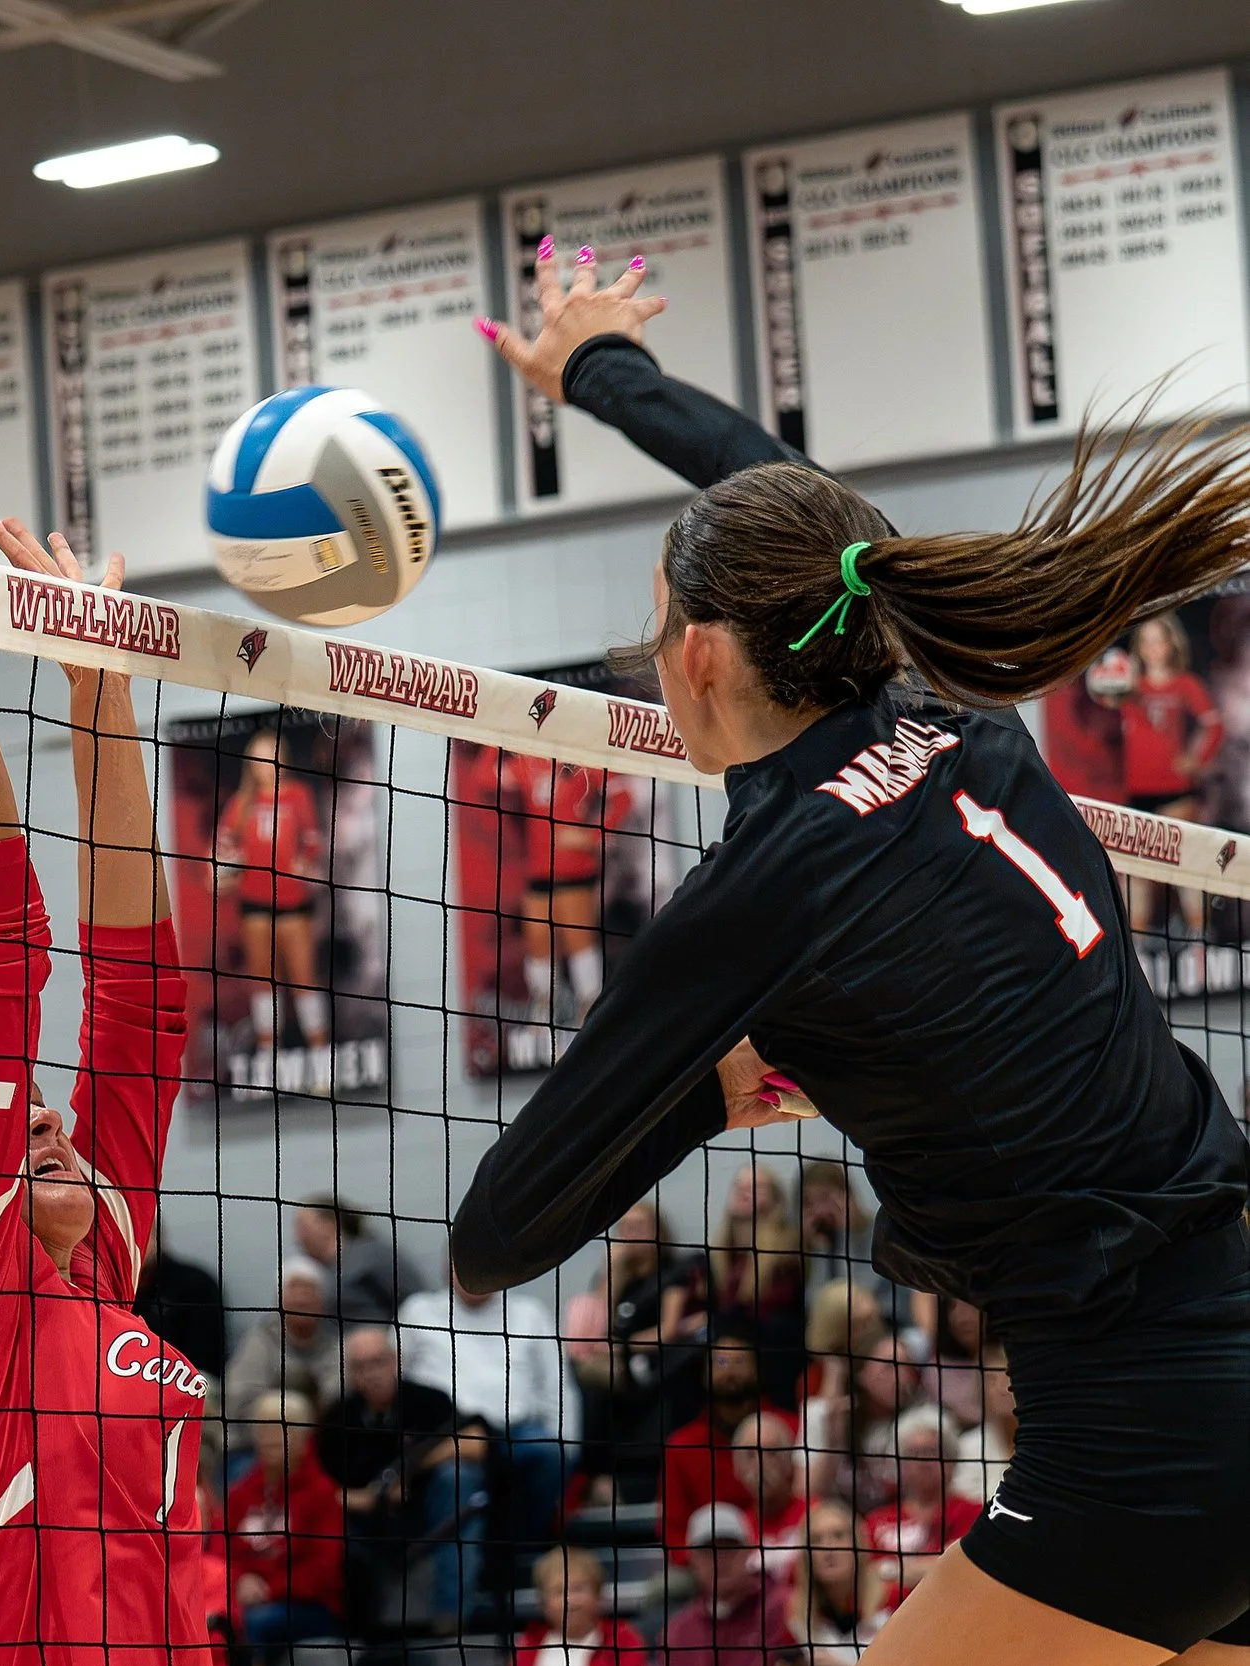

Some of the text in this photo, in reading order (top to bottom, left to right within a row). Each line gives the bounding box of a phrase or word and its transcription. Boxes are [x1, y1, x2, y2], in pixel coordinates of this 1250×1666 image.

[7, 575, 181, 660] WILLMAR
[325, 641, 479, 720] WILLMAR
[607, 699, 688, 760] WILL
[952, 789, 1105, 960] 1
